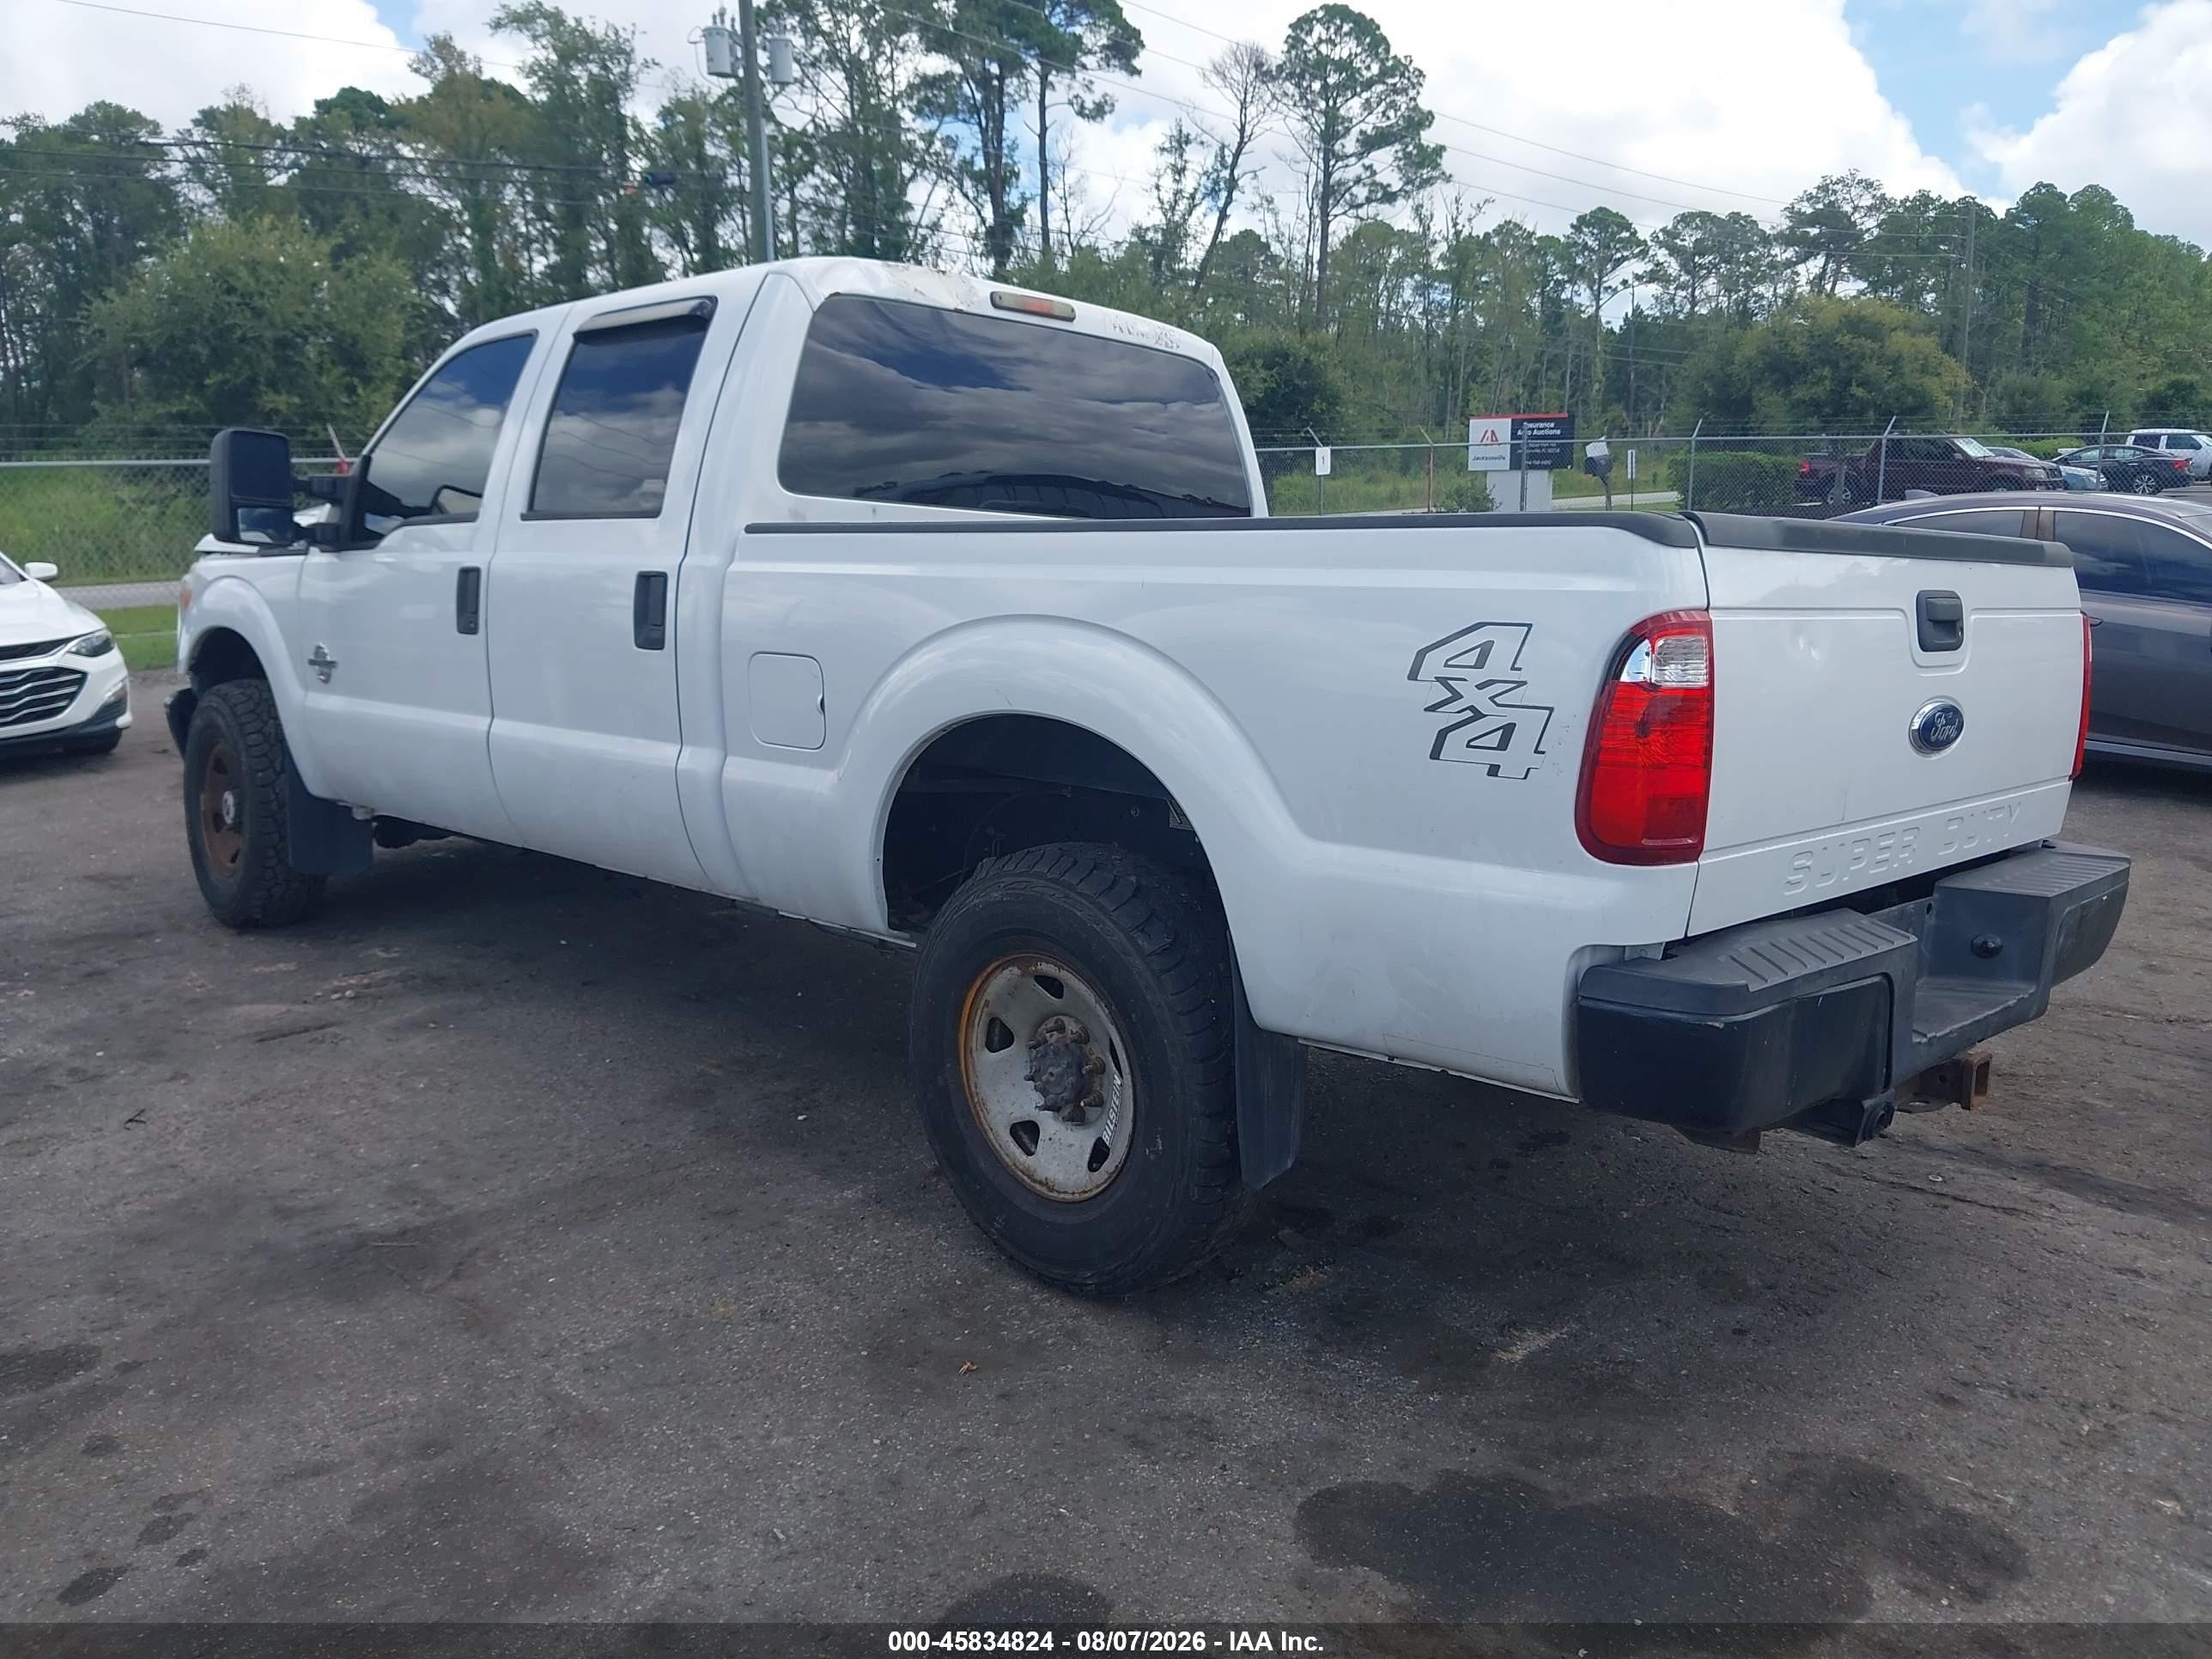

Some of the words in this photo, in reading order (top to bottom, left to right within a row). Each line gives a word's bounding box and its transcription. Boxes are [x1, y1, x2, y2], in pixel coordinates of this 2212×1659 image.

[1931, 712, 1959, 742] Ford
[1784, 827, 1921, 896] SUPER
[1938, 802, 2021, 856] DUTY
[1103, 1073, 1121, 1146] BILSTEIN
